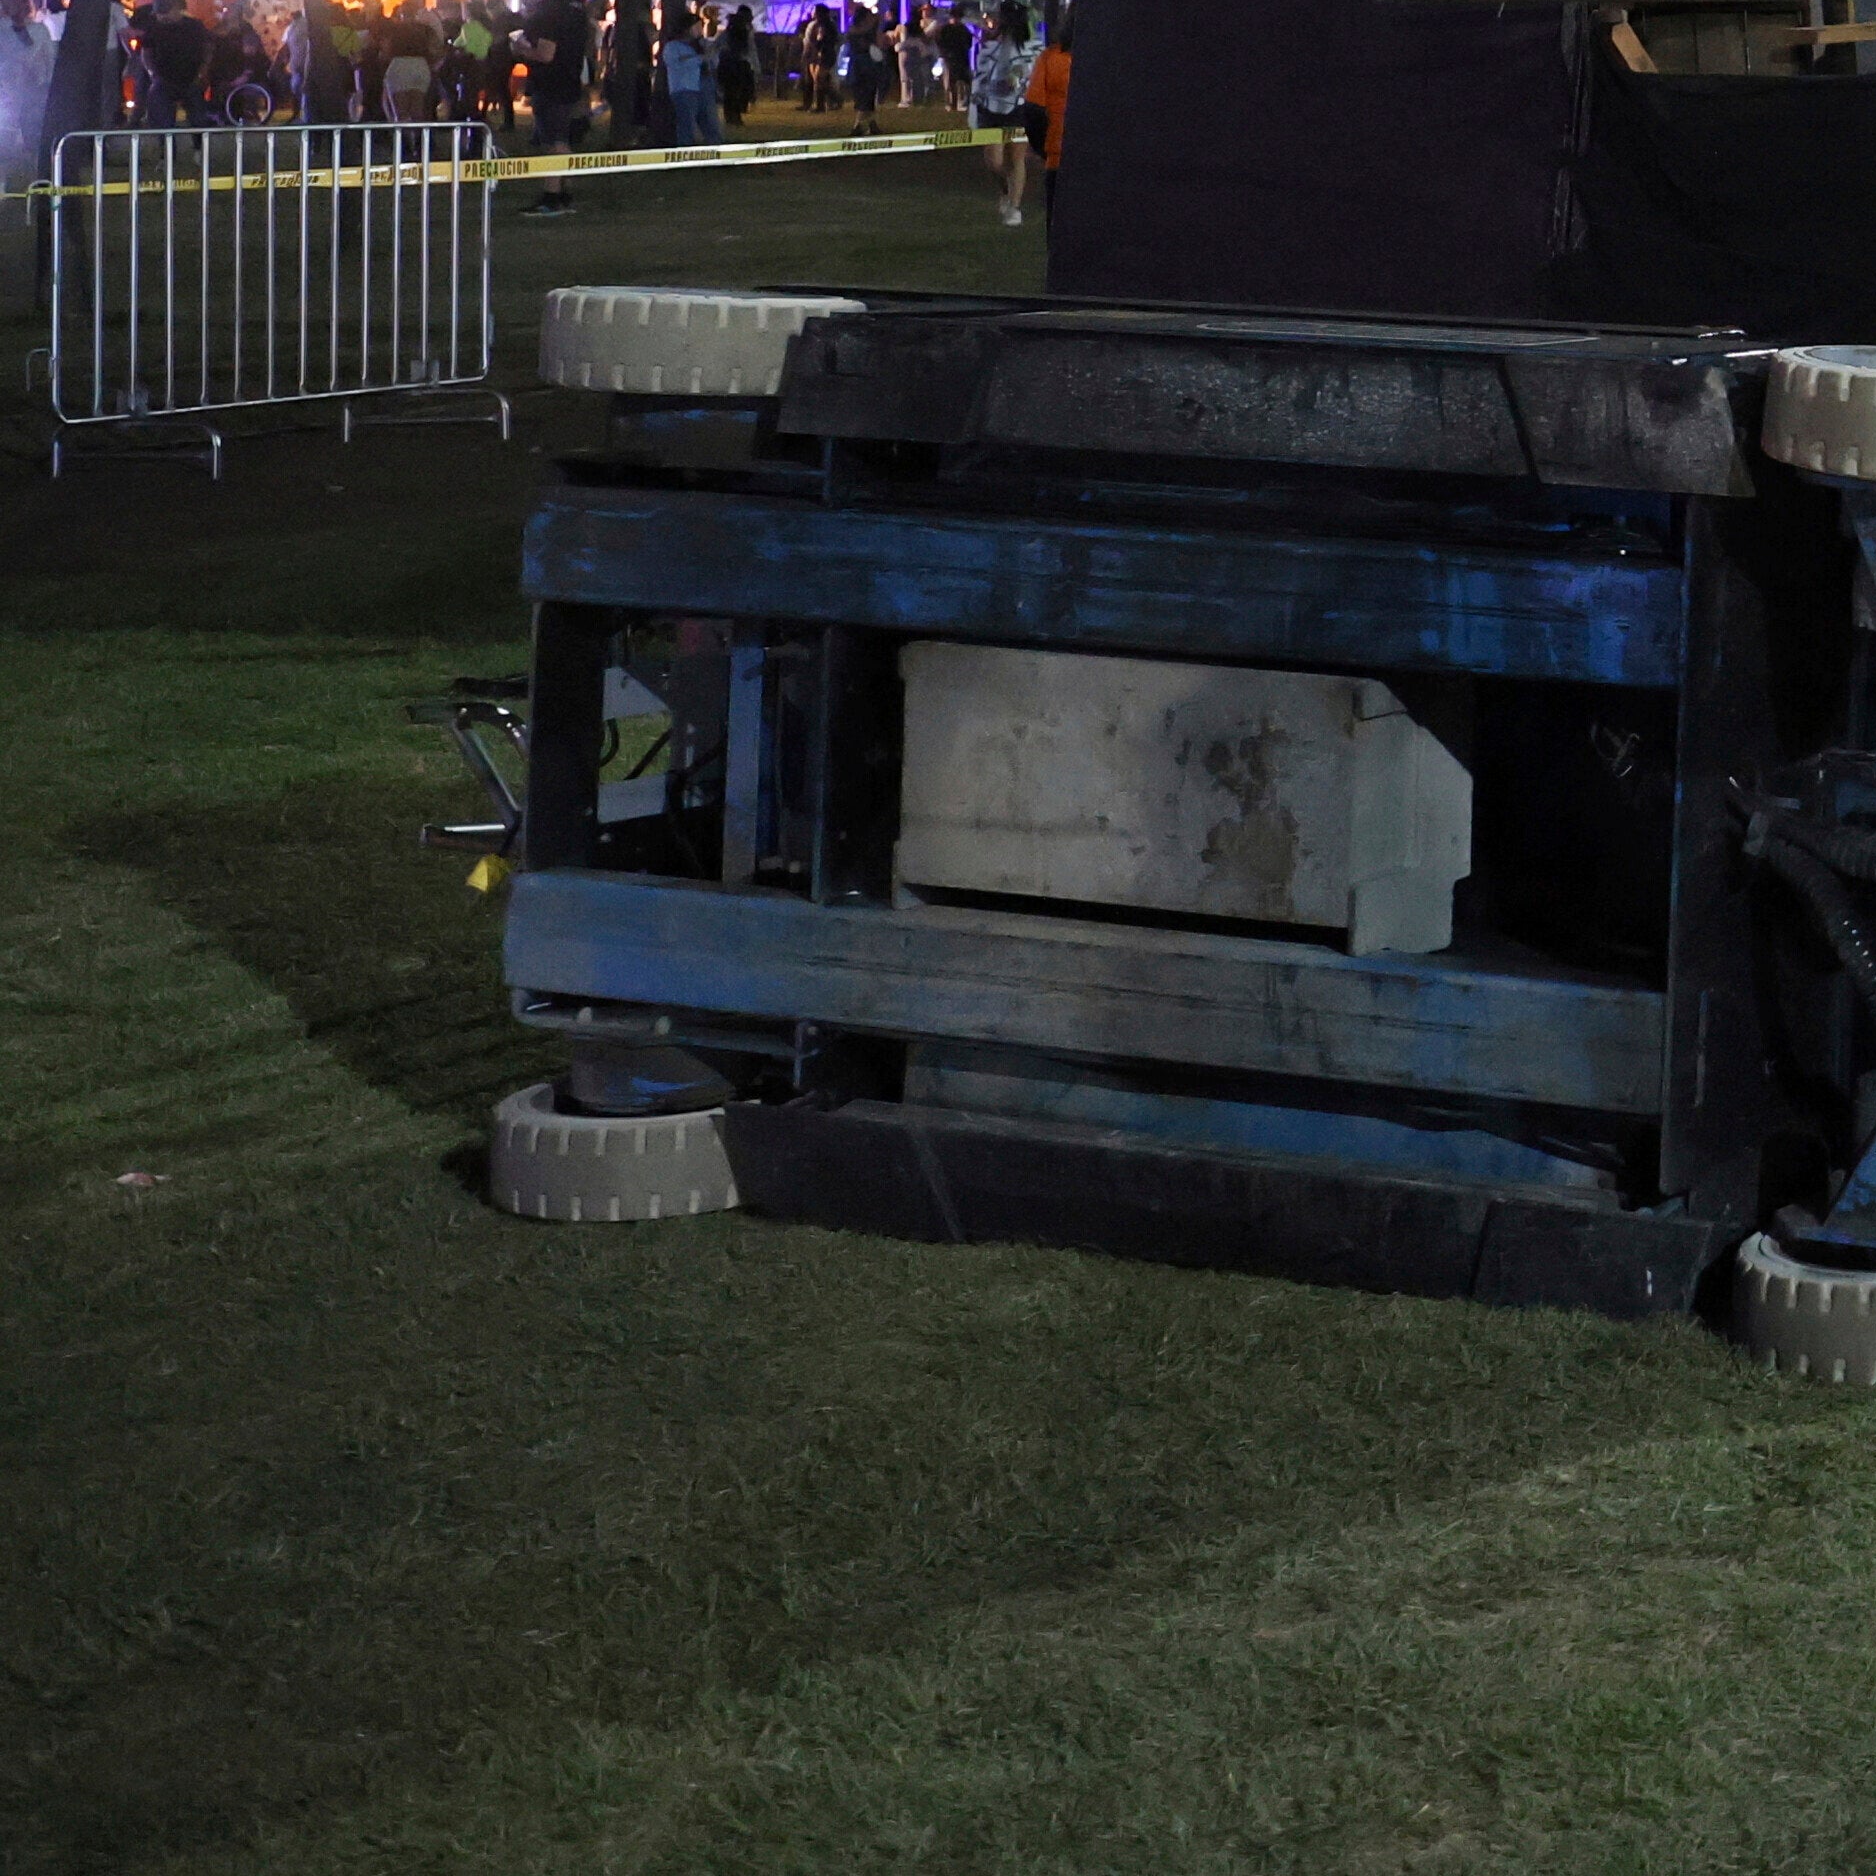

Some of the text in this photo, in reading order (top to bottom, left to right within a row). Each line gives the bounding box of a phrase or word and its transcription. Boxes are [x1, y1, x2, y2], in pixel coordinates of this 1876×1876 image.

[464, 160, 529, 178] PRECAUCION
[568, 154, 628, 170] PRECAUCION
[664, 150, 721, 163] PRECAUCION
